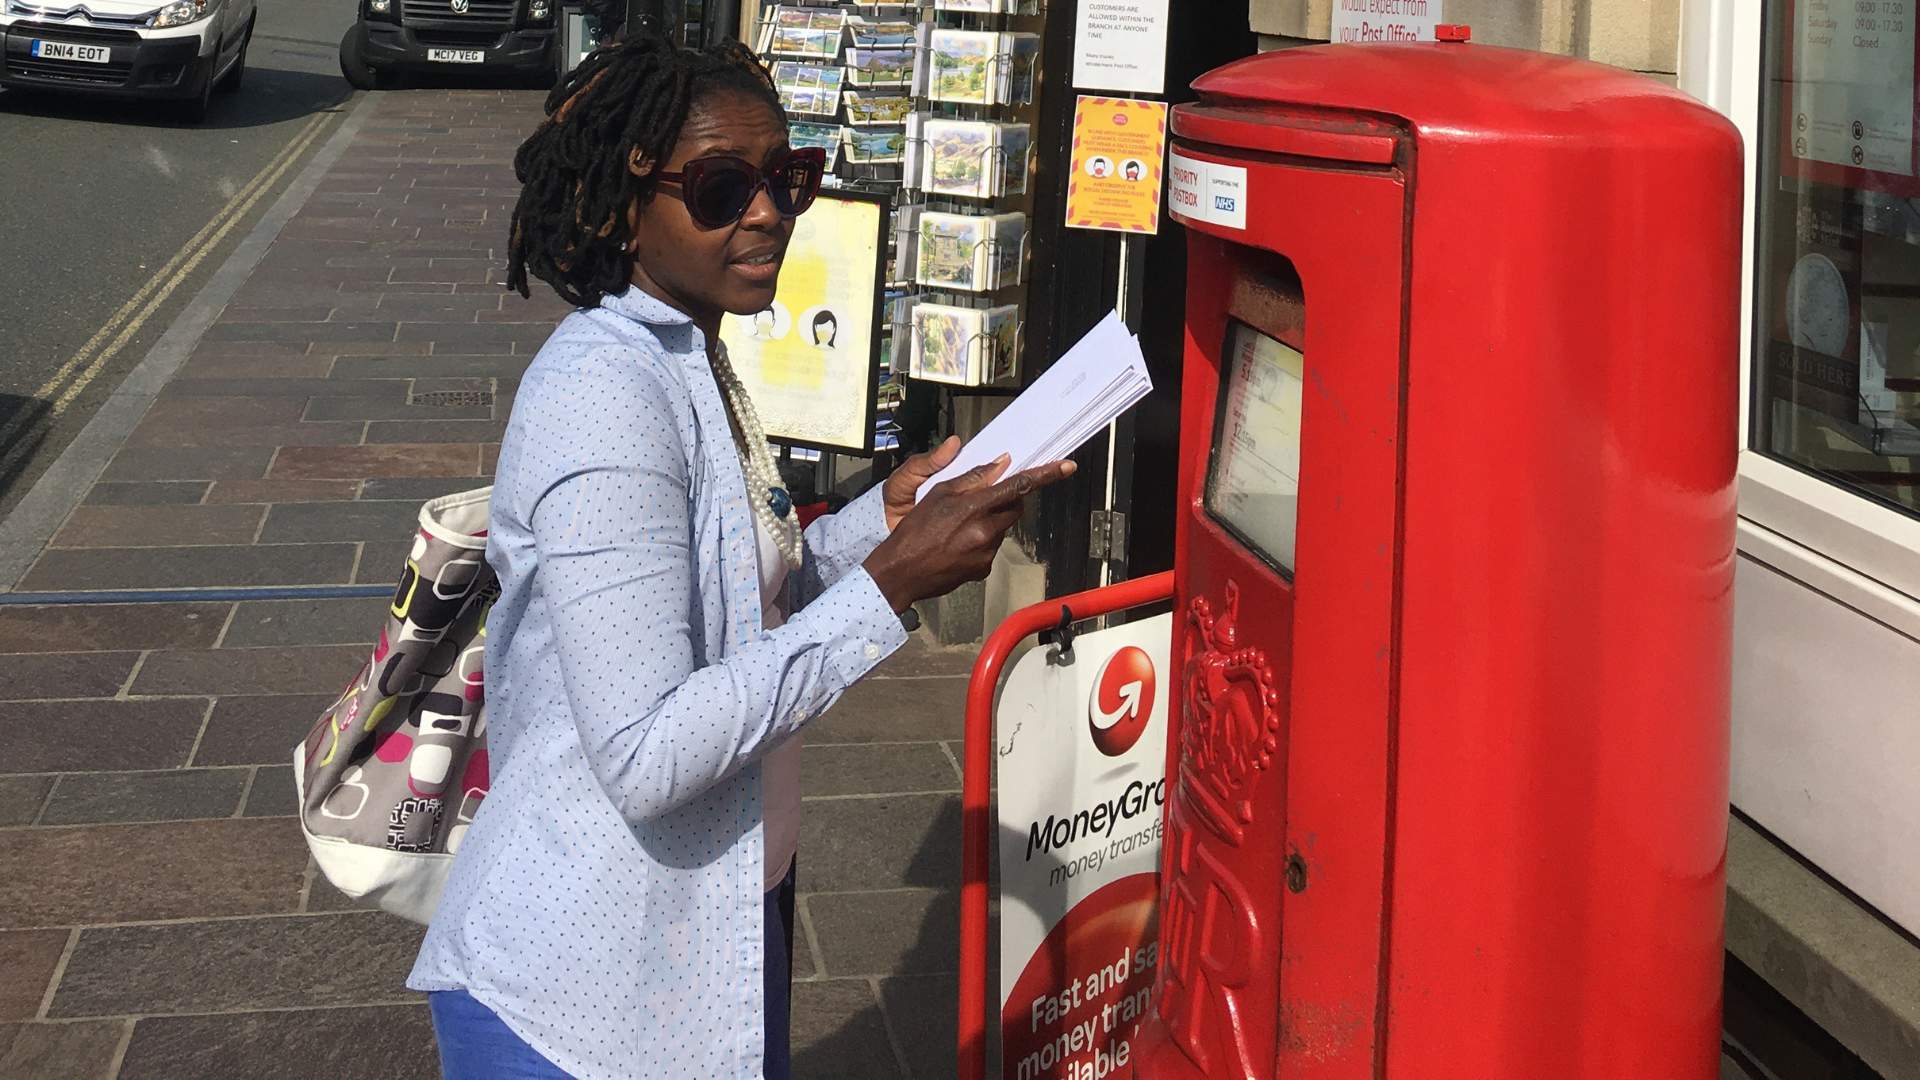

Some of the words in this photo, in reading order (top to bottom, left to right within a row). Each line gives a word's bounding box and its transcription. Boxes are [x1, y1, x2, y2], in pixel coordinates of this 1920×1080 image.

[1088, 3, 1126, 12] CUSTOMERS
[1088, 13, 1118, 21] ALLOWED
[1087, 22, 1113, 30] BRANCH
[1123, 25, 1148, 33] ANYONE
[1087, 31, 1103, 39] TIME
[1361, 21, 1383, 42] Post
[1852, 35, 1880, 48] Closed
[44, 43, 74, 58] BN14
[78, 47, 104, 60] EOT
[459, 51, 478, 61] VEG
[1173, 165, 1198, 186] PRIORITY
[1173, 186, 1198, 207] POSTBOX
[1215, 196, 1234, 212] NHS
[1049, 846, 1108, 887] money
[1032, 978, 1082, 1033] Fast
[1085, 946, 1130, 1001] and
[1017, 1015, 1098, 1080] money
